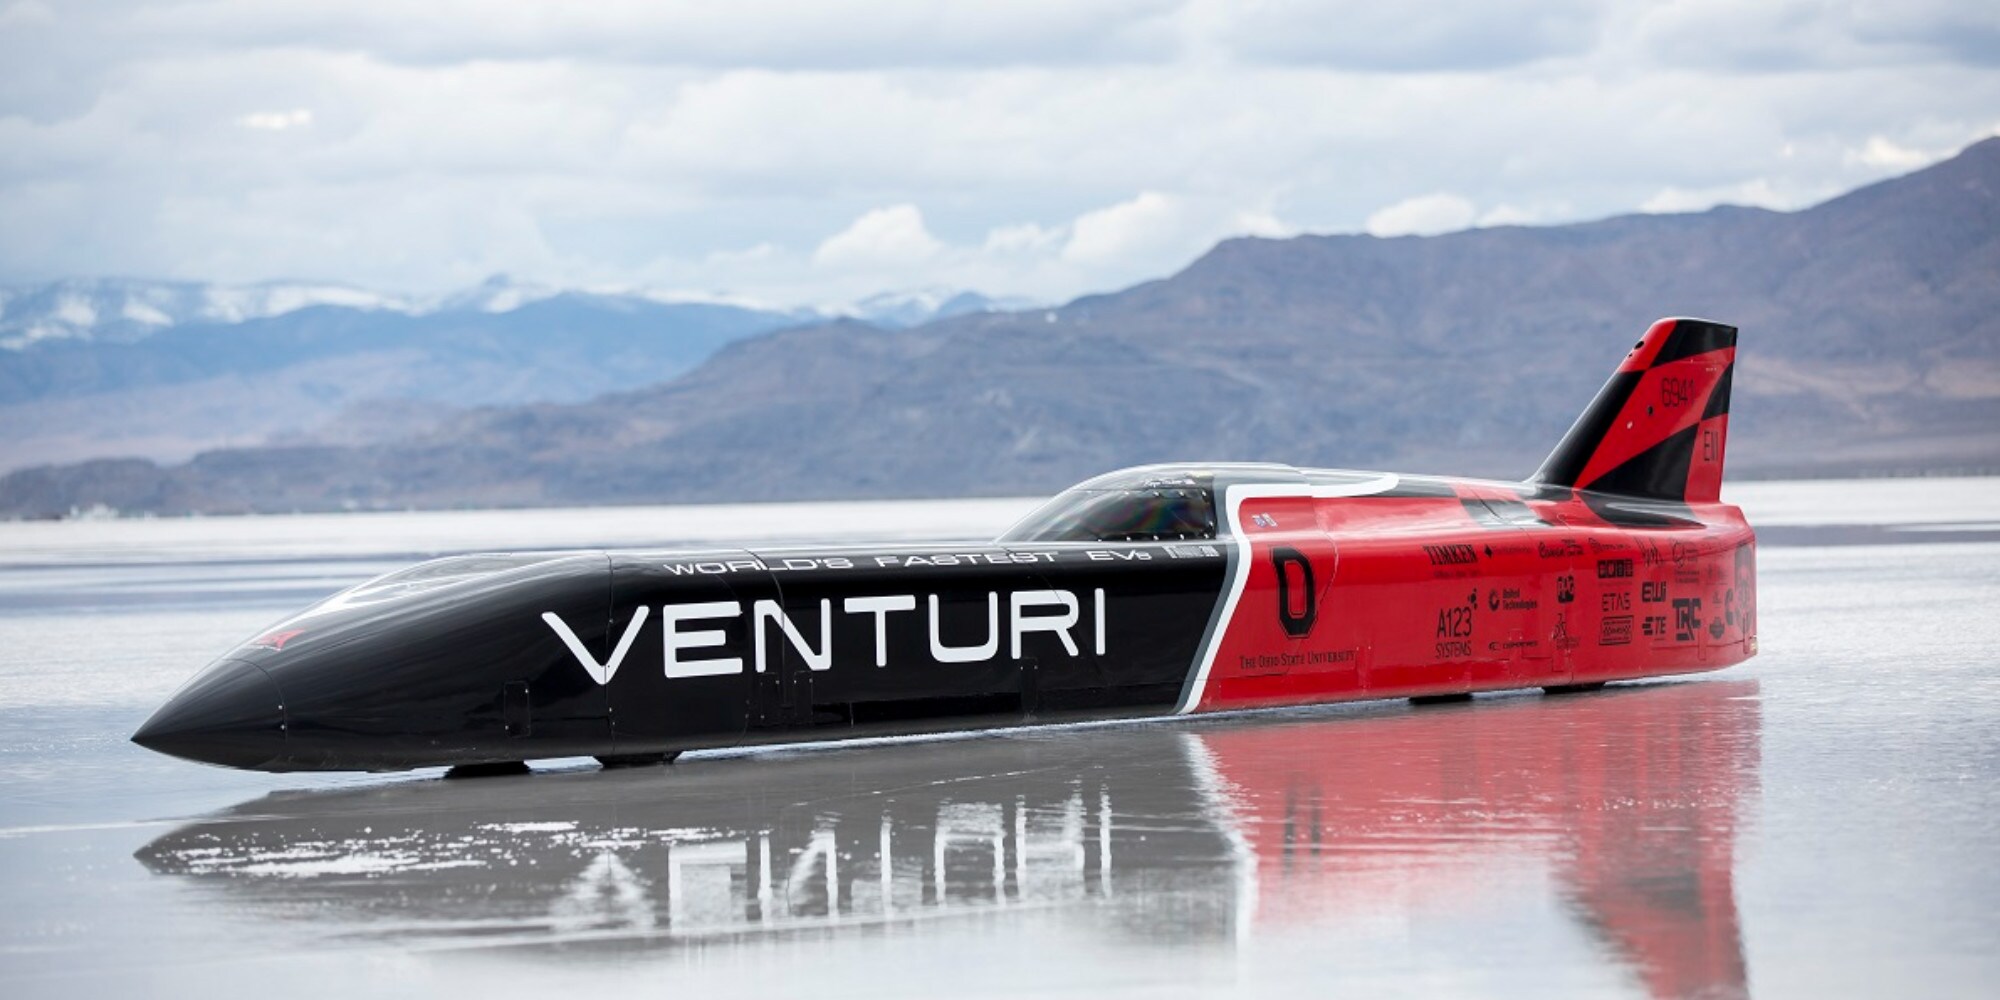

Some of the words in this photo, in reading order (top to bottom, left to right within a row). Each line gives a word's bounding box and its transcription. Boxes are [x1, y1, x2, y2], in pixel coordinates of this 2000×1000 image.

[1662, 377, 1694, 406] 6941
[663, 557, 854, 576] WORLD'S
[874, 551, 1060, 568] FASTEST
[1423, 544, 1478, 565] TIMKEN
[1602, 592, 1631, 612] ETAS
[1437, 606, 1472, 638] A123
[541, 588, 1106, 685] VENTURI
[1435, 640, 1472, 659] SYSTEMS
